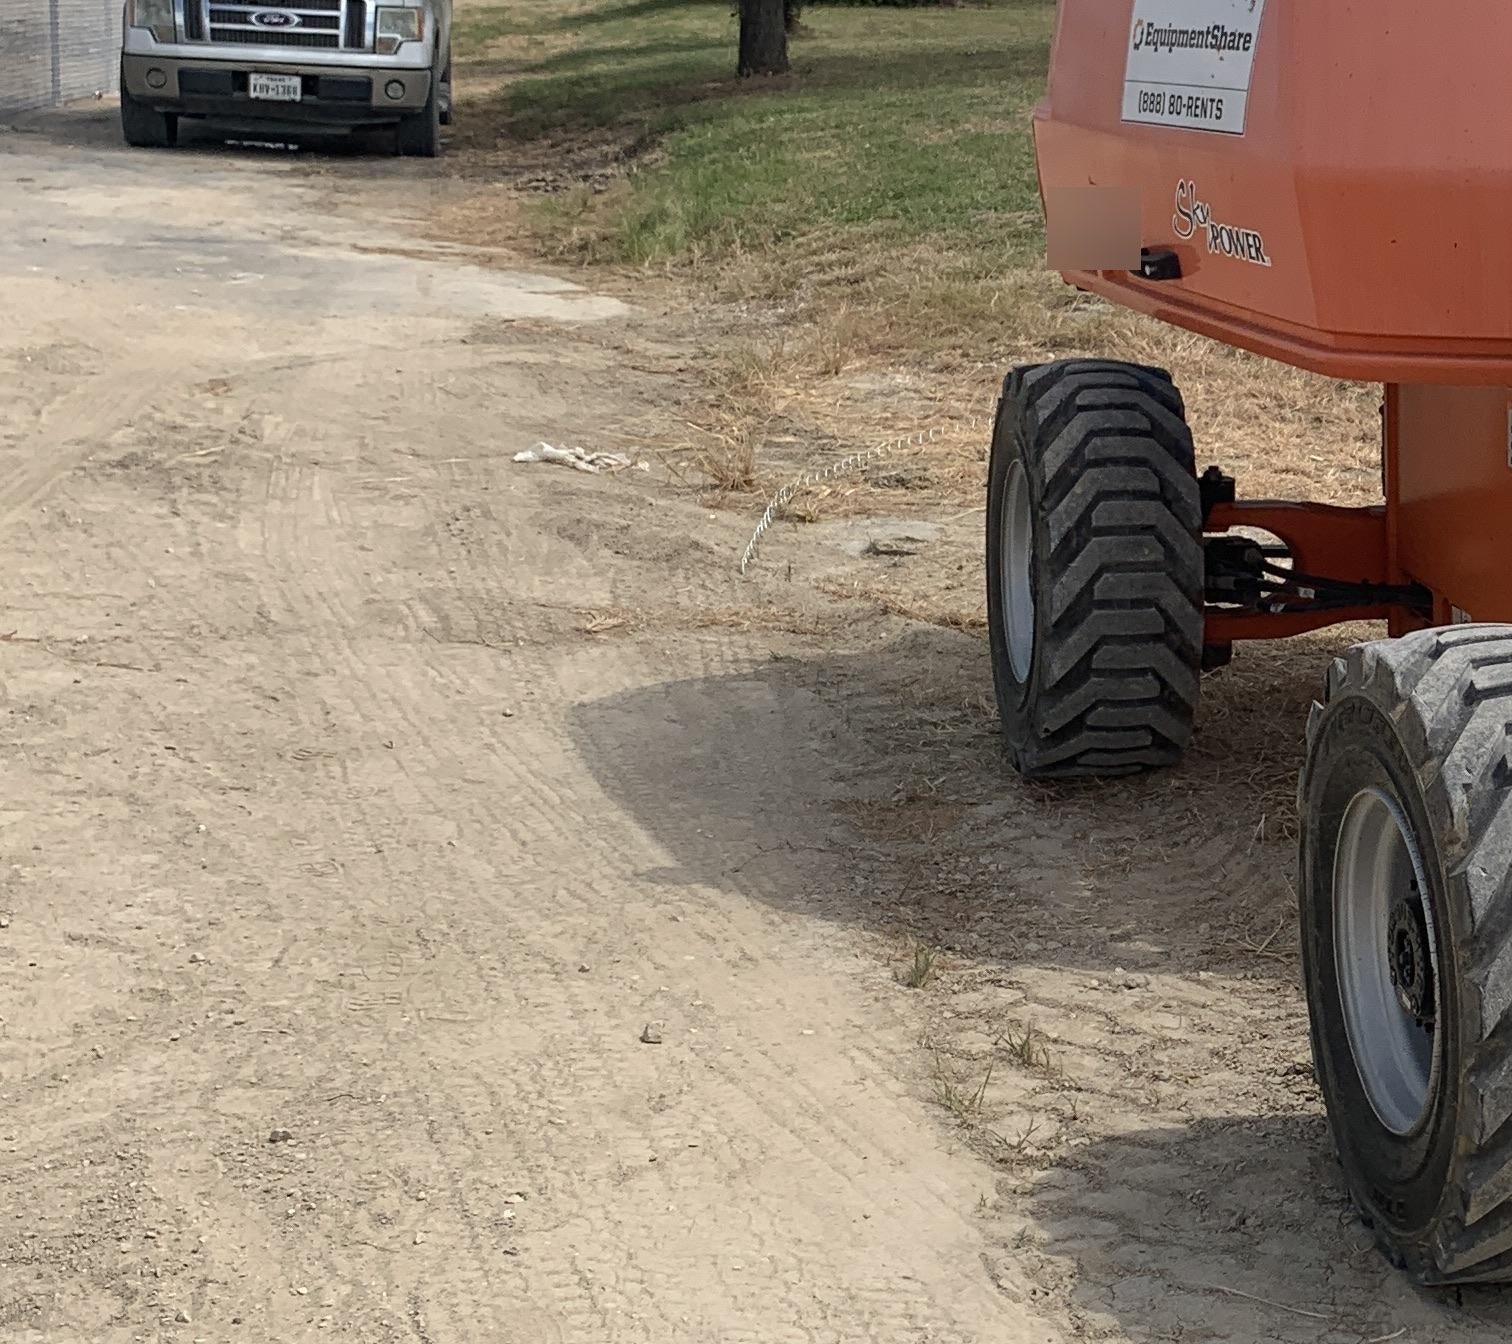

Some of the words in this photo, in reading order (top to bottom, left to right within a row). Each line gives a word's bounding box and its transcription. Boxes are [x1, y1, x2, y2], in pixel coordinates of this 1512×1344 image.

[1144, 22, 1253, 53] EquipmentShare
[1138, 89, 1166, 117] (888)
[1168, 93, 1224, 121] 80-RENTS
